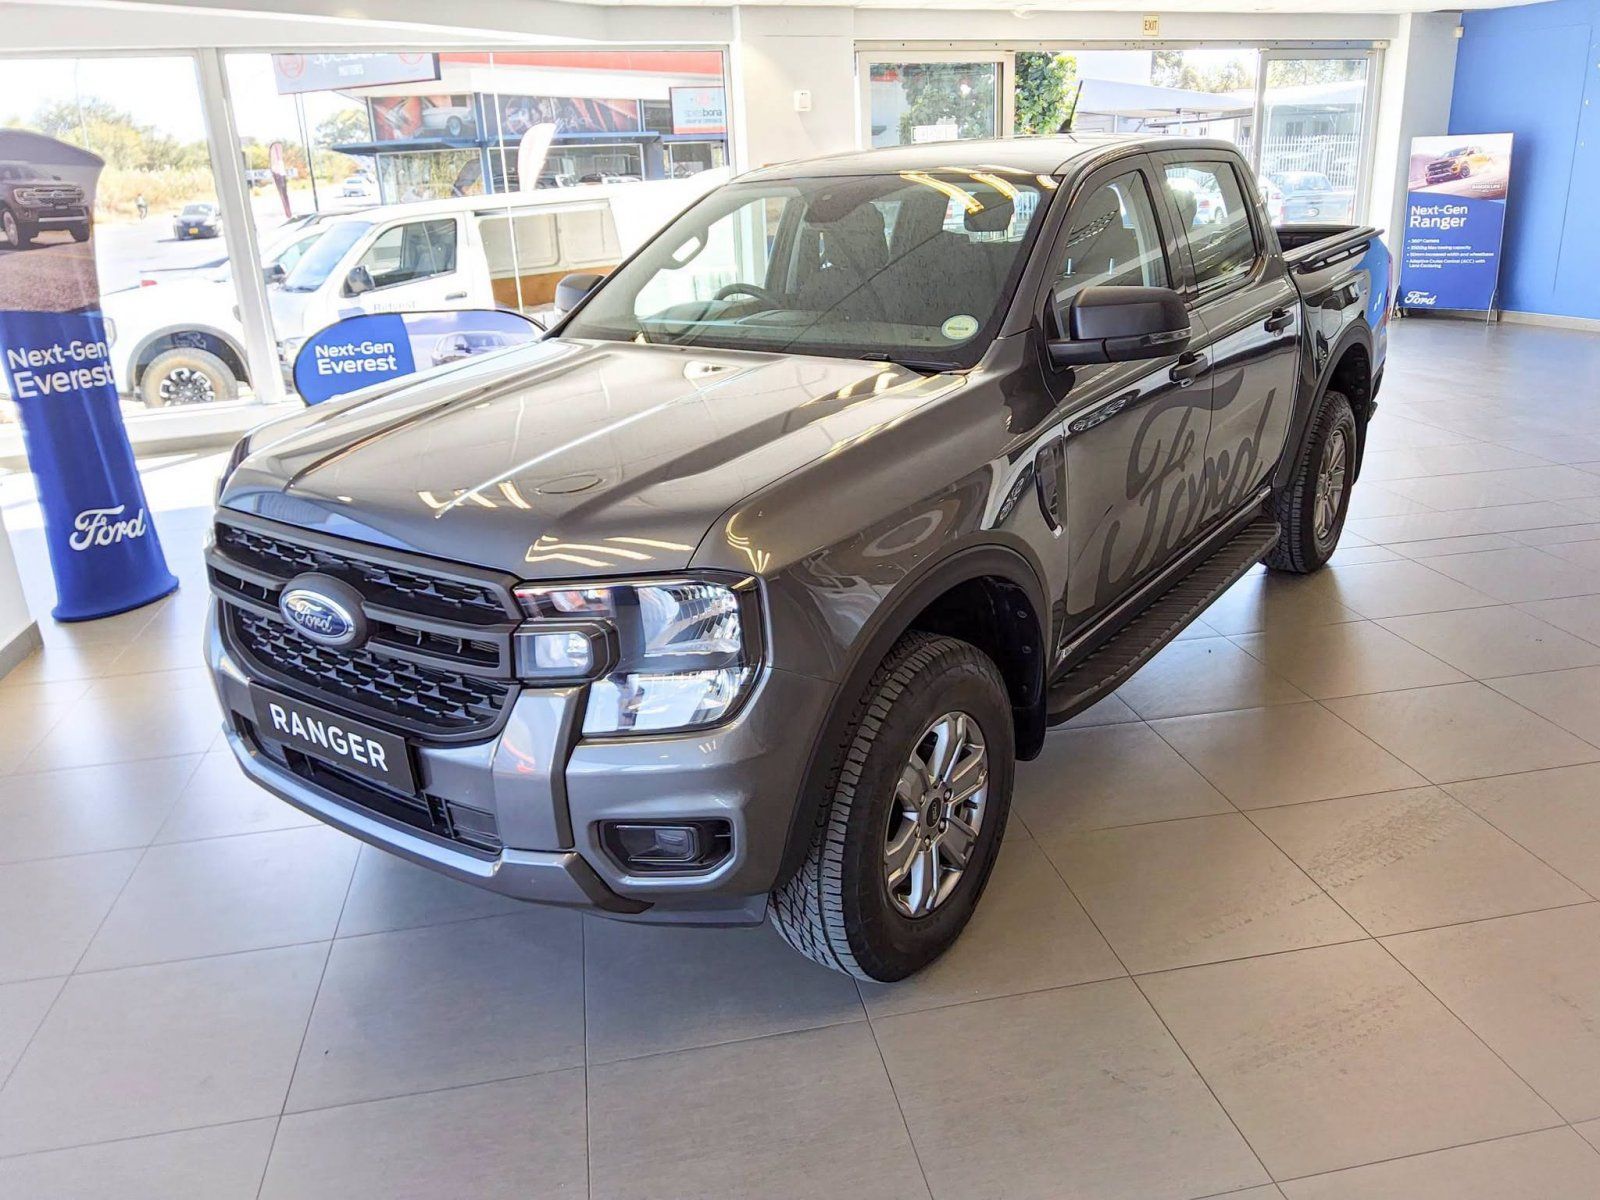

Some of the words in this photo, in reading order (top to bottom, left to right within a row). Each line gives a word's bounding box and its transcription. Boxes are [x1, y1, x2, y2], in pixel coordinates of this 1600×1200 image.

[1144, 19, 1157, 31] EXIT
[1410, 215, 1467, 230] Ranger
[1411, 205, 1468, 215] Next-Gen
[1404, 290, 1436, 305] Ford
[7, 340, 108, 370] Next-Gen
[315, 341, 395, 358] Next-Gen
[317, 355, 398, 375] Everest
[14, 365, 115, 399] Everest
[1094, 368, 1276, 608] Ford
[69, 504, 147, 552] Ford
[291, 601, 333, 632] Ford
[269, 703, 388, 772] RANGER
